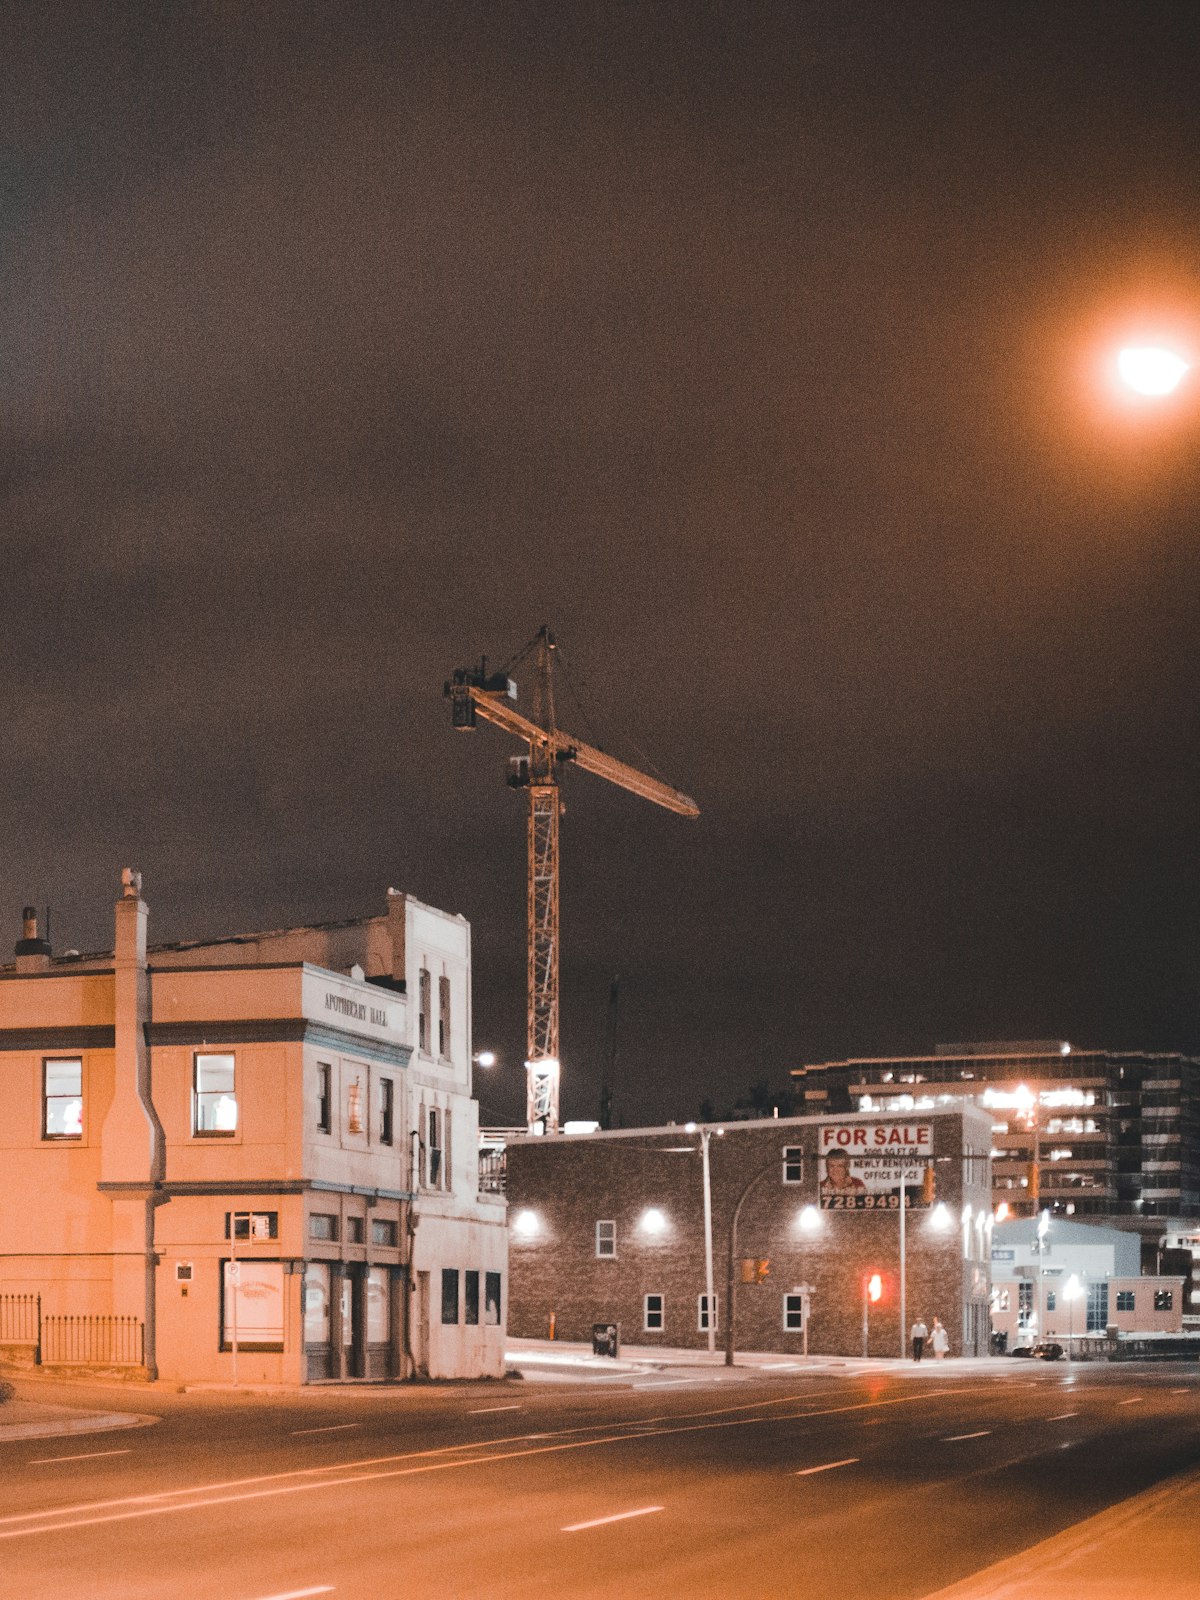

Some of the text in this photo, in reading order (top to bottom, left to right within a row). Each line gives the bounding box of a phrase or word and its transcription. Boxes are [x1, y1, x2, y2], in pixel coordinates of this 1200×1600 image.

[325, 992, 388, 1027] APOTHECARY HALL
[823, 1127, 929, 1146] FOR SALE
[853, 1158, 880, 1168] NEWLY
[863, 1171, 891, 1179] OFFICE
